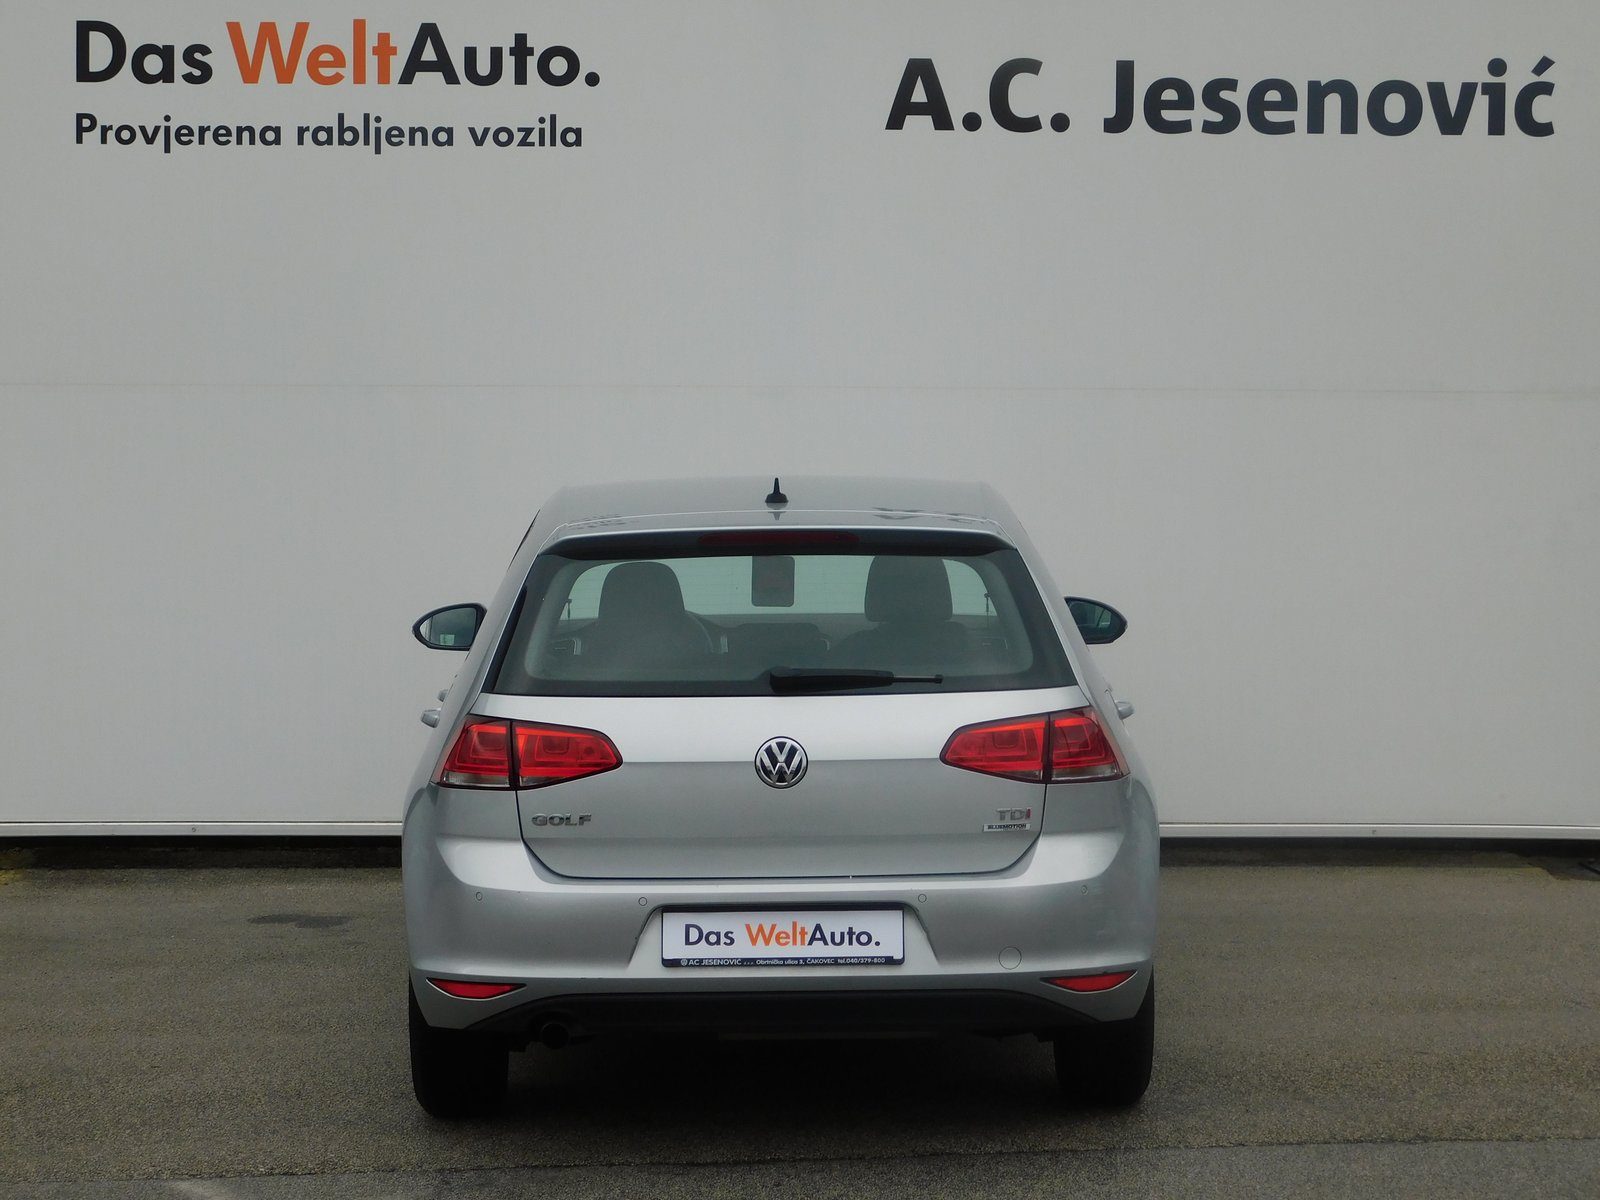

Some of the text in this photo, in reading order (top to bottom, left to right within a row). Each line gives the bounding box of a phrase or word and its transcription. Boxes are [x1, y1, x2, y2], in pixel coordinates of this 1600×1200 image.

[76, 19, 601, 88] Das WeltAuto.
[885, 56, 1556, 137] A.C. Jesenović
[76, 112, 582, 155] Provjerena rabljena vozila
[531, 814, 592, 826] GOLF
[996, 808, 1032, 821] TDI
[684, 921, 881, 947] Das WeltAuto.
